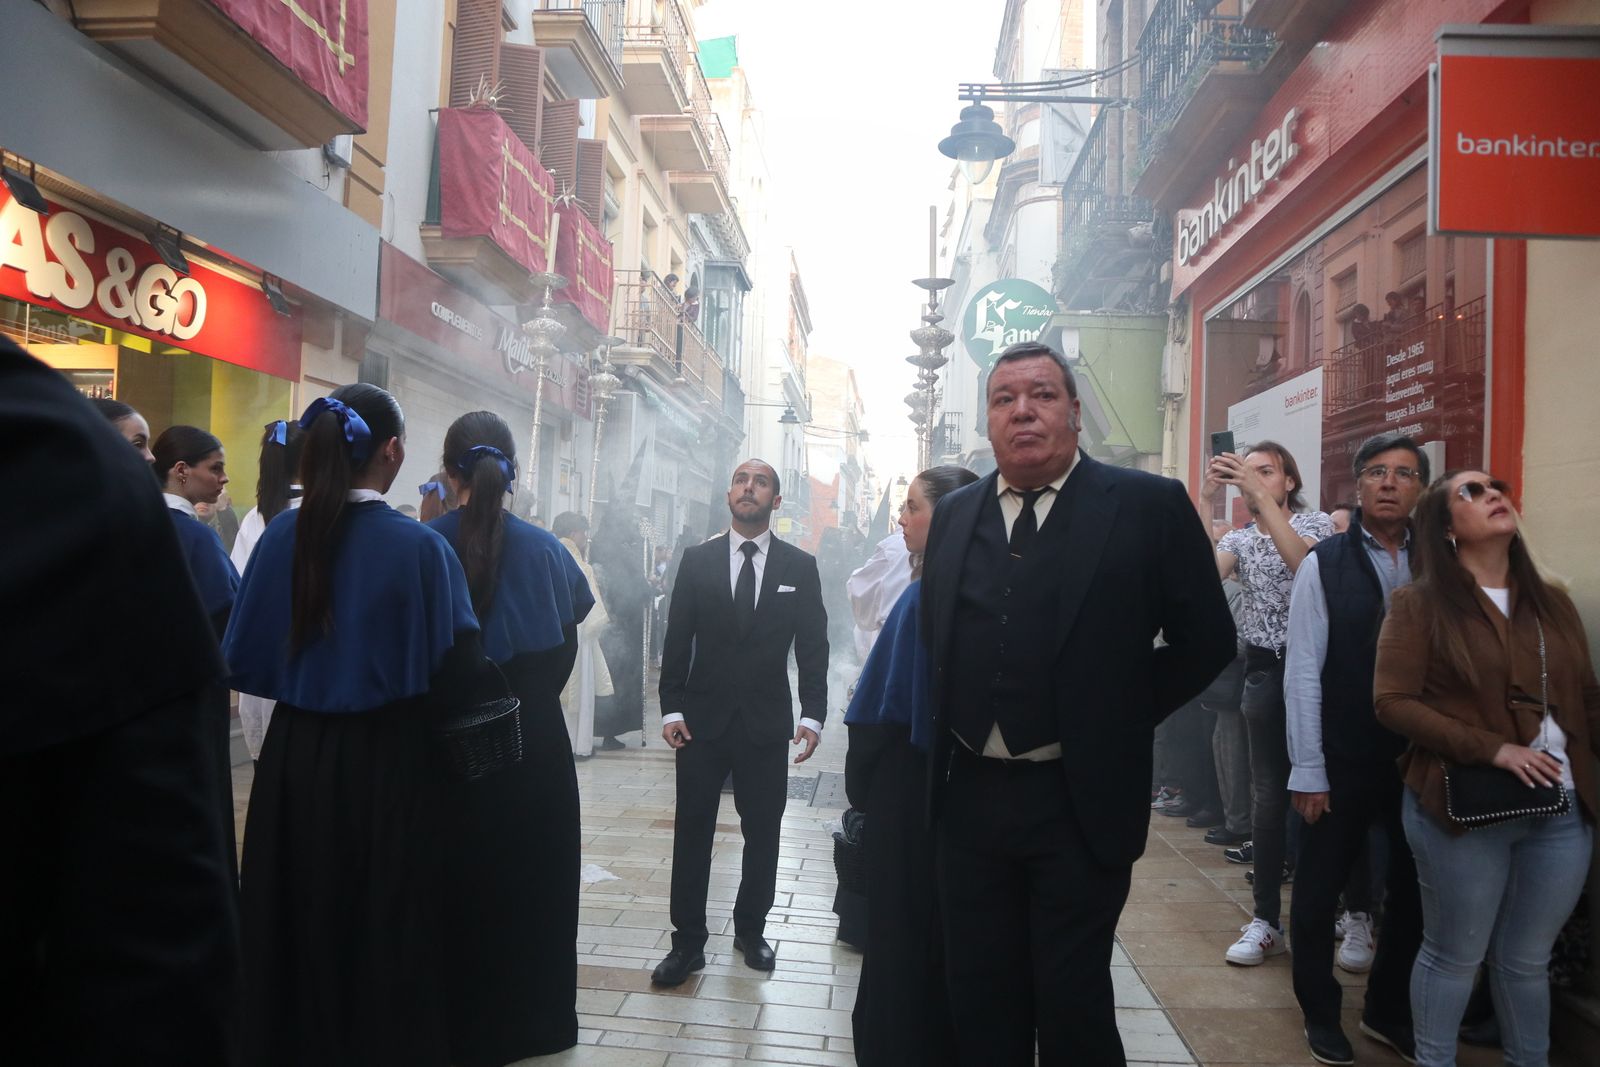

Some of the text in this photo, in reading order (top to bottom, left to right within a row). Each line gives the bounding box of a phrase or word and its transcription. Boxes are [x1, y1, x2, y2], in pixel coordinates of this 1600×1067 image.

[1386, 341, 1424, 367] Desde 1965
[1401, 366, 1416, 380] eres
[1417, 360, 1434, 374] muy
[1385, 395, 1434, 422] tengas la edad
